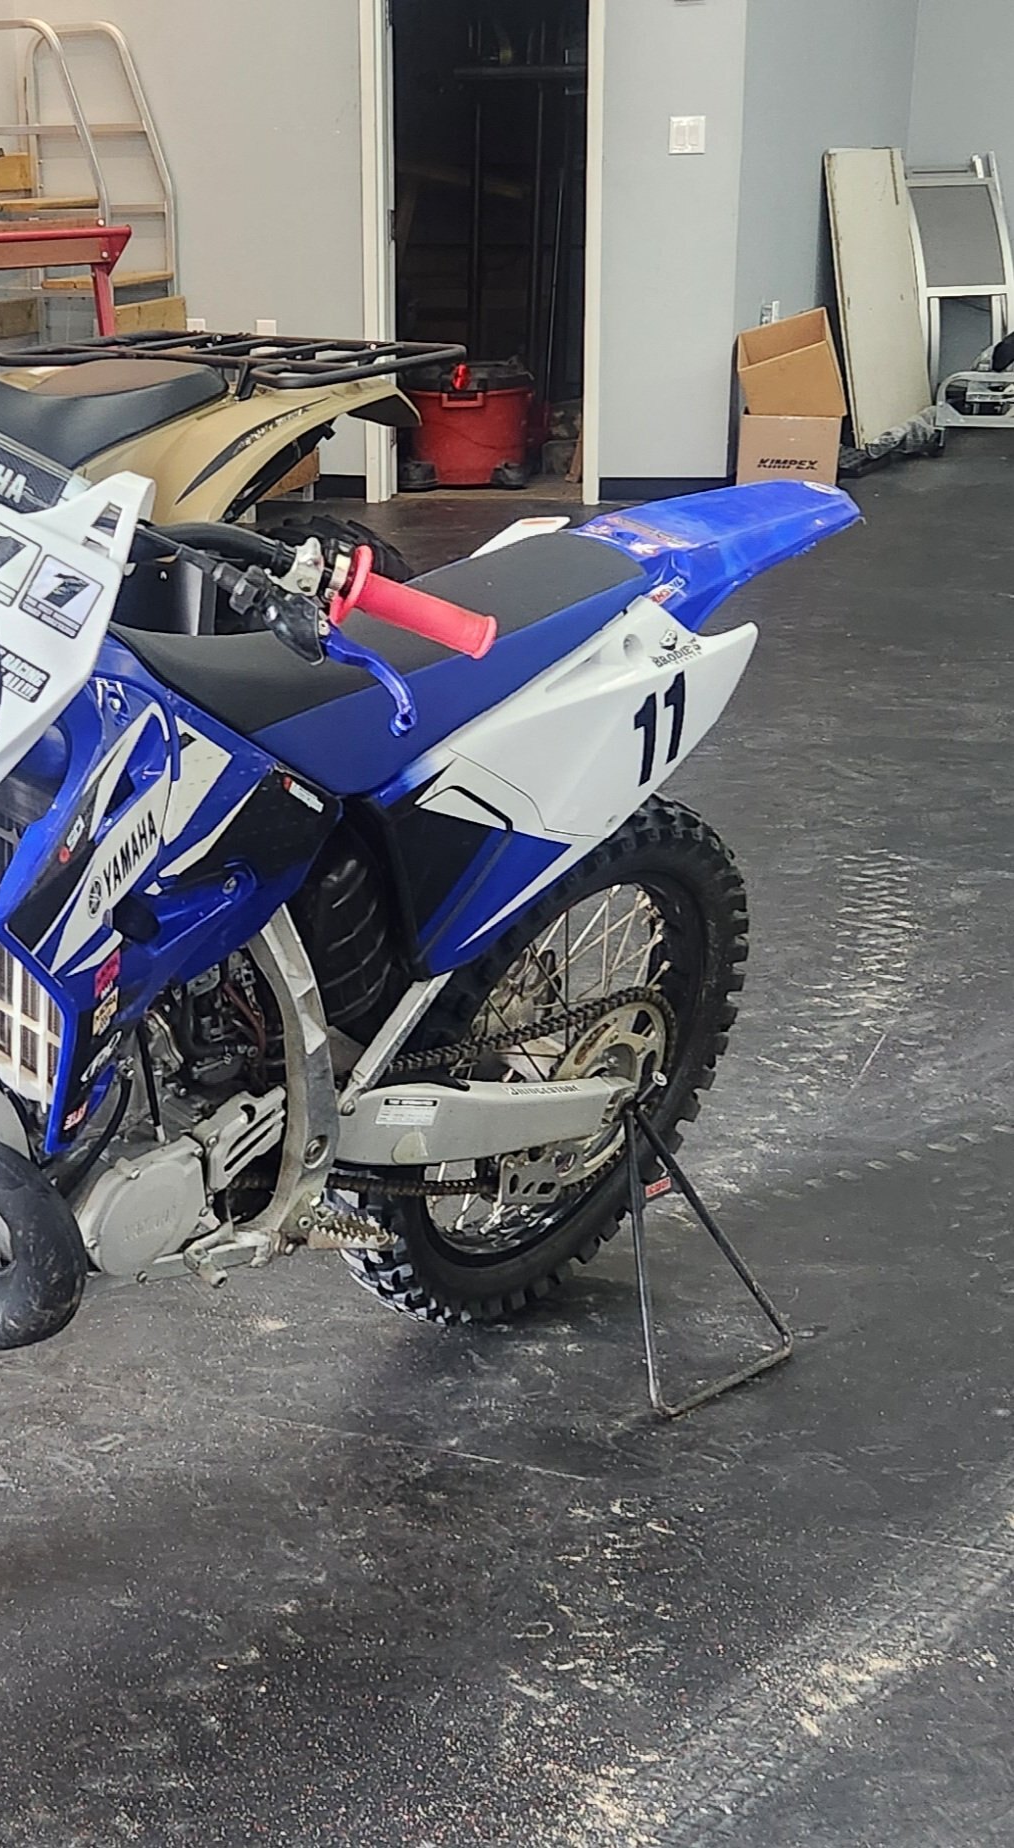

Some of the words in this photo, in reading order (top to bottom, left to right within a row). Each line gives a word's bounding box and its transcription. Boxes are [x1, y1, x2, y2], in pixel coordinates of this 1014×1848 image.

[757, 458, 818, 471] KIMPEX
[634, 670, 685, 787] 11
[103, 810, 157, 897] YAMAHA
